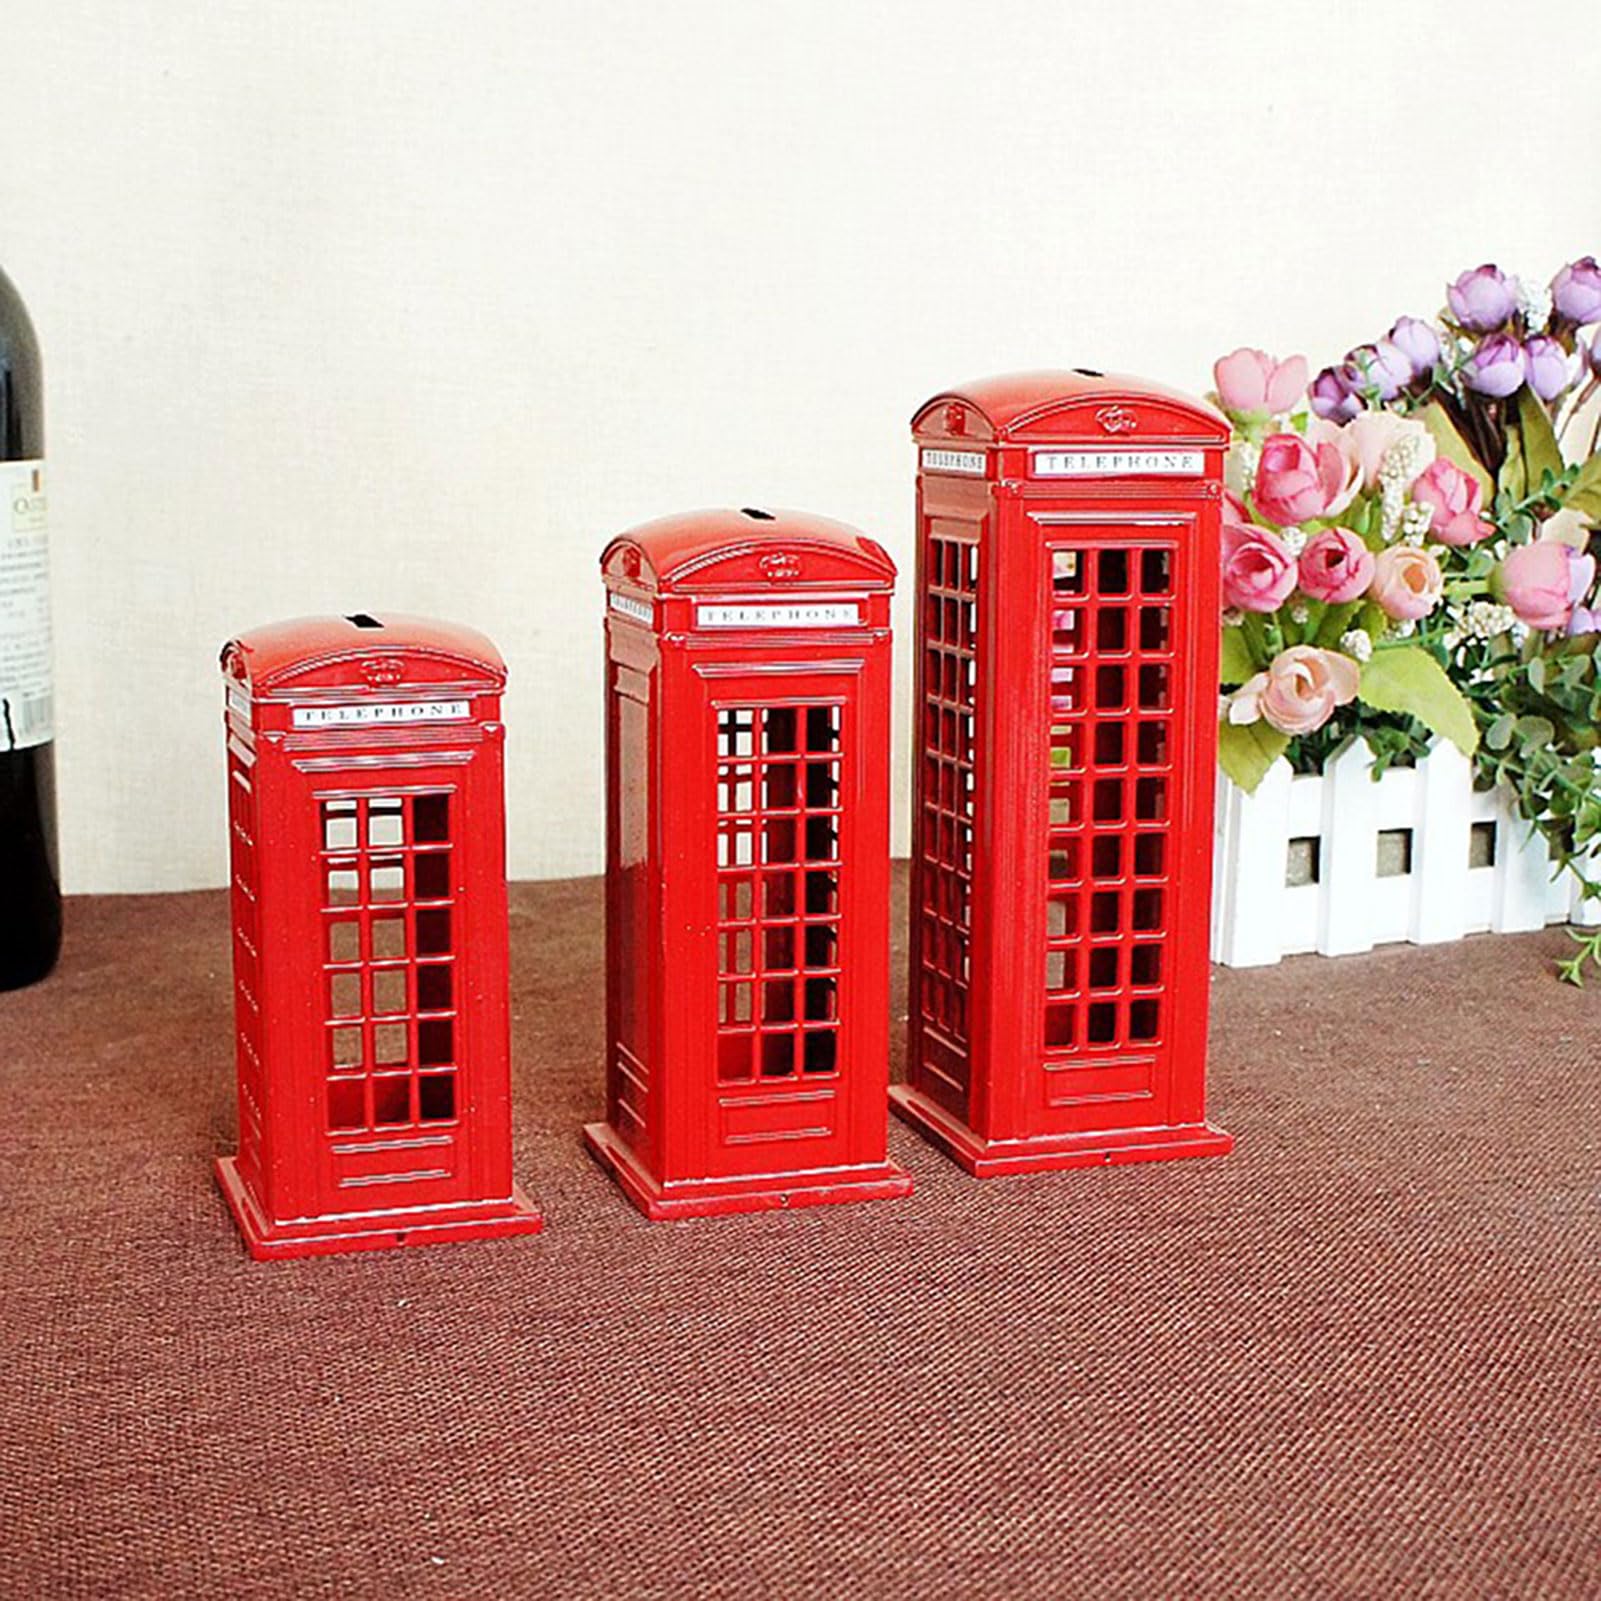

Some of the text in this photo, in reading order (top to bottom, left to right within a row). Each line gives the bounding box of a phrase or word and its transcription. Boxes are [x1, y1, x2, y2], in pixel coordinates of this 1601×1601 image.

[1047, 455, 1194, 470] TELEPHONE
[706, 608, 854, 622] TELEPHONE
[305, 703, 462, 721] TELEPHONE
